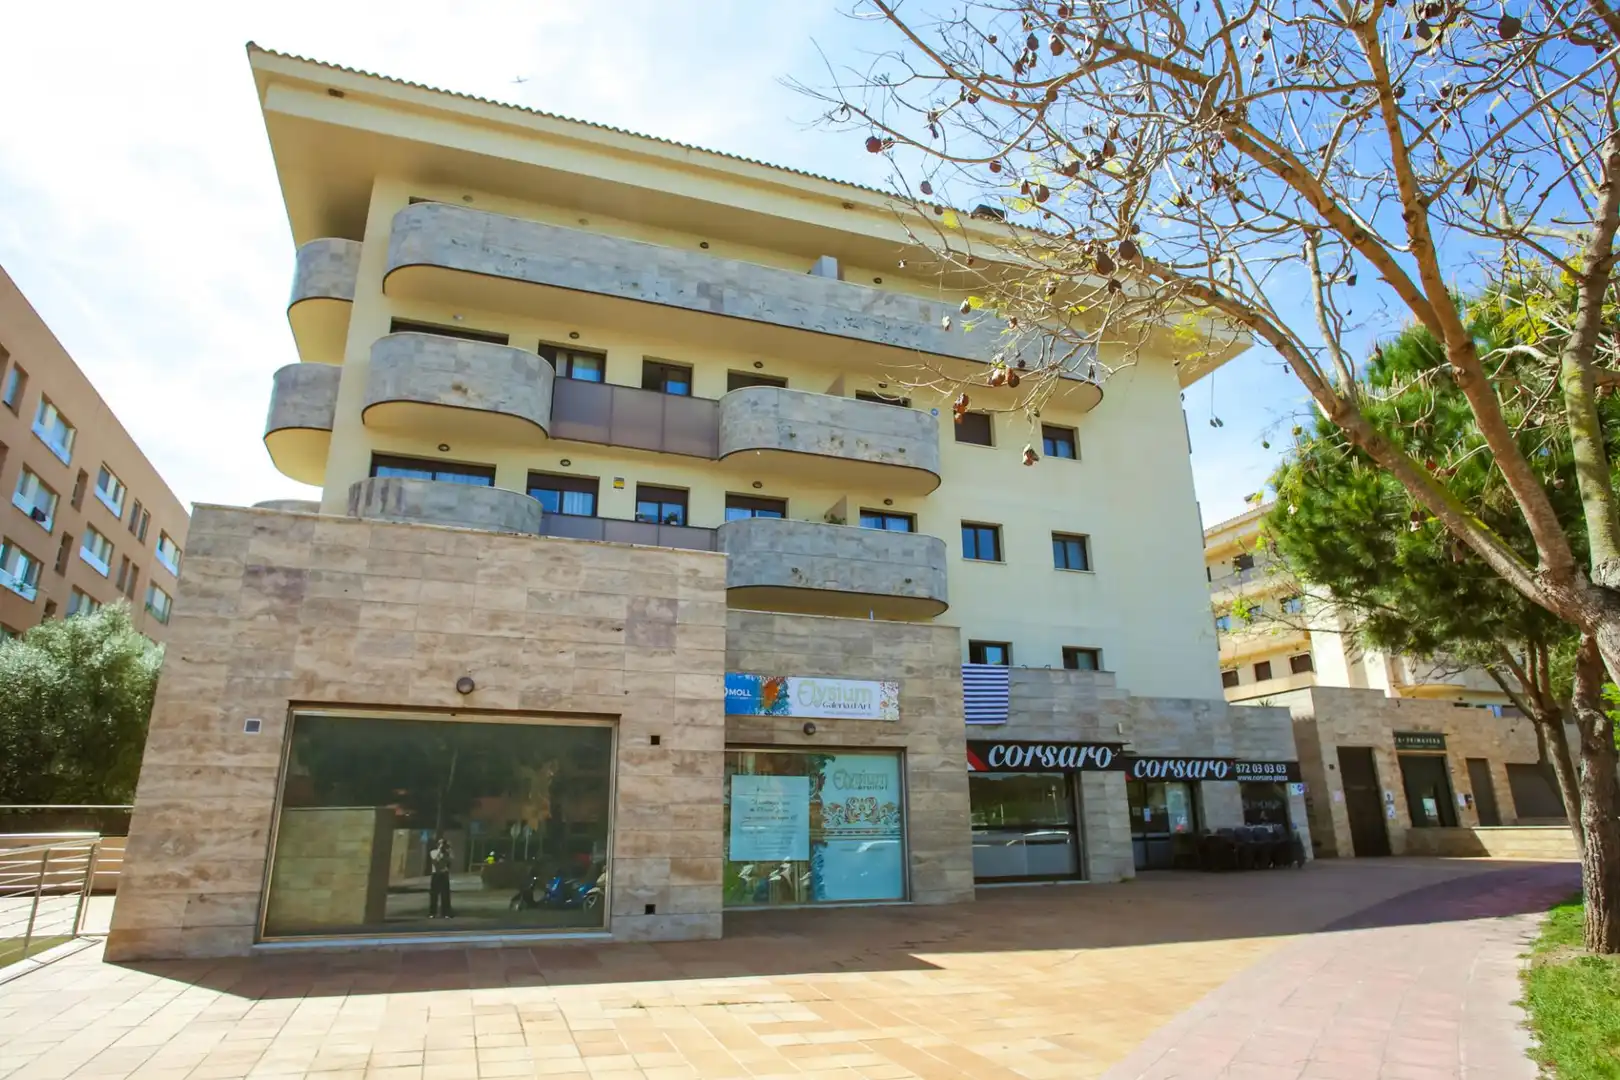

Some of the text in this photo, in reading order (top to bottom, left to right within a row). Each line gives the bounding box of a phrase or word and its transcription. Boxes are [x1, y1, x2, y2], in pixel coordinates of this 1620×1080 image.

[797, 679, 873, 708] Elysium
[988, 744, 1116, 768] corsaro
[1134, 759, 1230, 778] corsaro
[1252, 763, 1263, 774] 03
[1264, 763, 1275, 774] 03
[1276, 763, 1287, 774] 03
